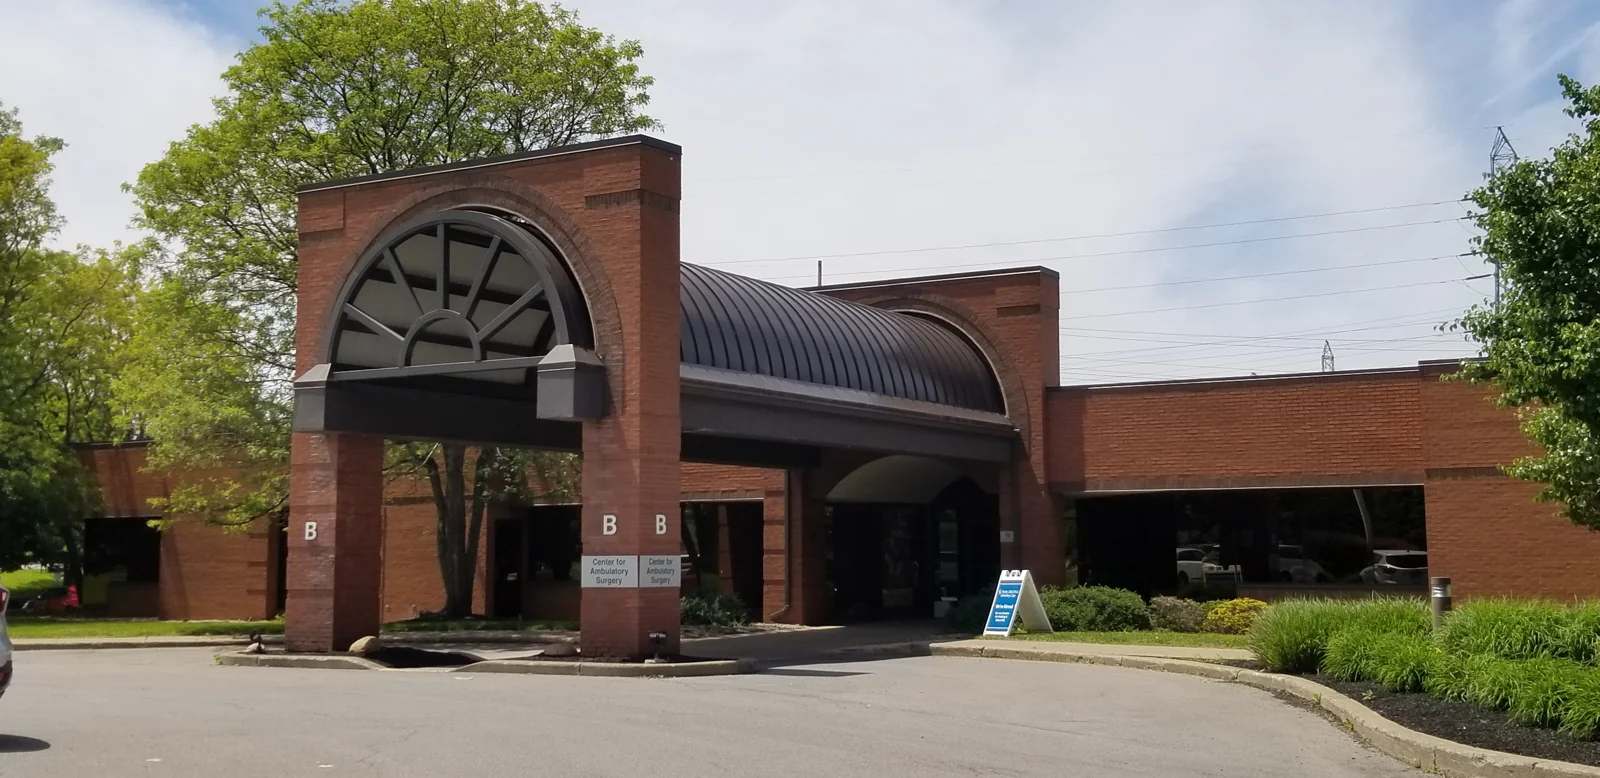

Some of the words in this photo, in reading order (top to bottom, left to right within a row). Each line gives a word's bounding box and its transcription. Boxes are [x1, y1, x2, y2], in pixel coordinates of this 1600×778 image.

[603, 514, 617, 535] B
[656, 514, 667, 535] B
[305, 521, 317, 540] B
[592, 558, 614, 566] Center
[616, 558, 626, 566] for
[648, 558, 665, 566] Center
[590, 567, 629, 576] Ambulatory
[646, 567, 675, 576] Ambulatory
[596, 577, 623, 586] Surgery
[650, 576, 671, 585] Surgery
